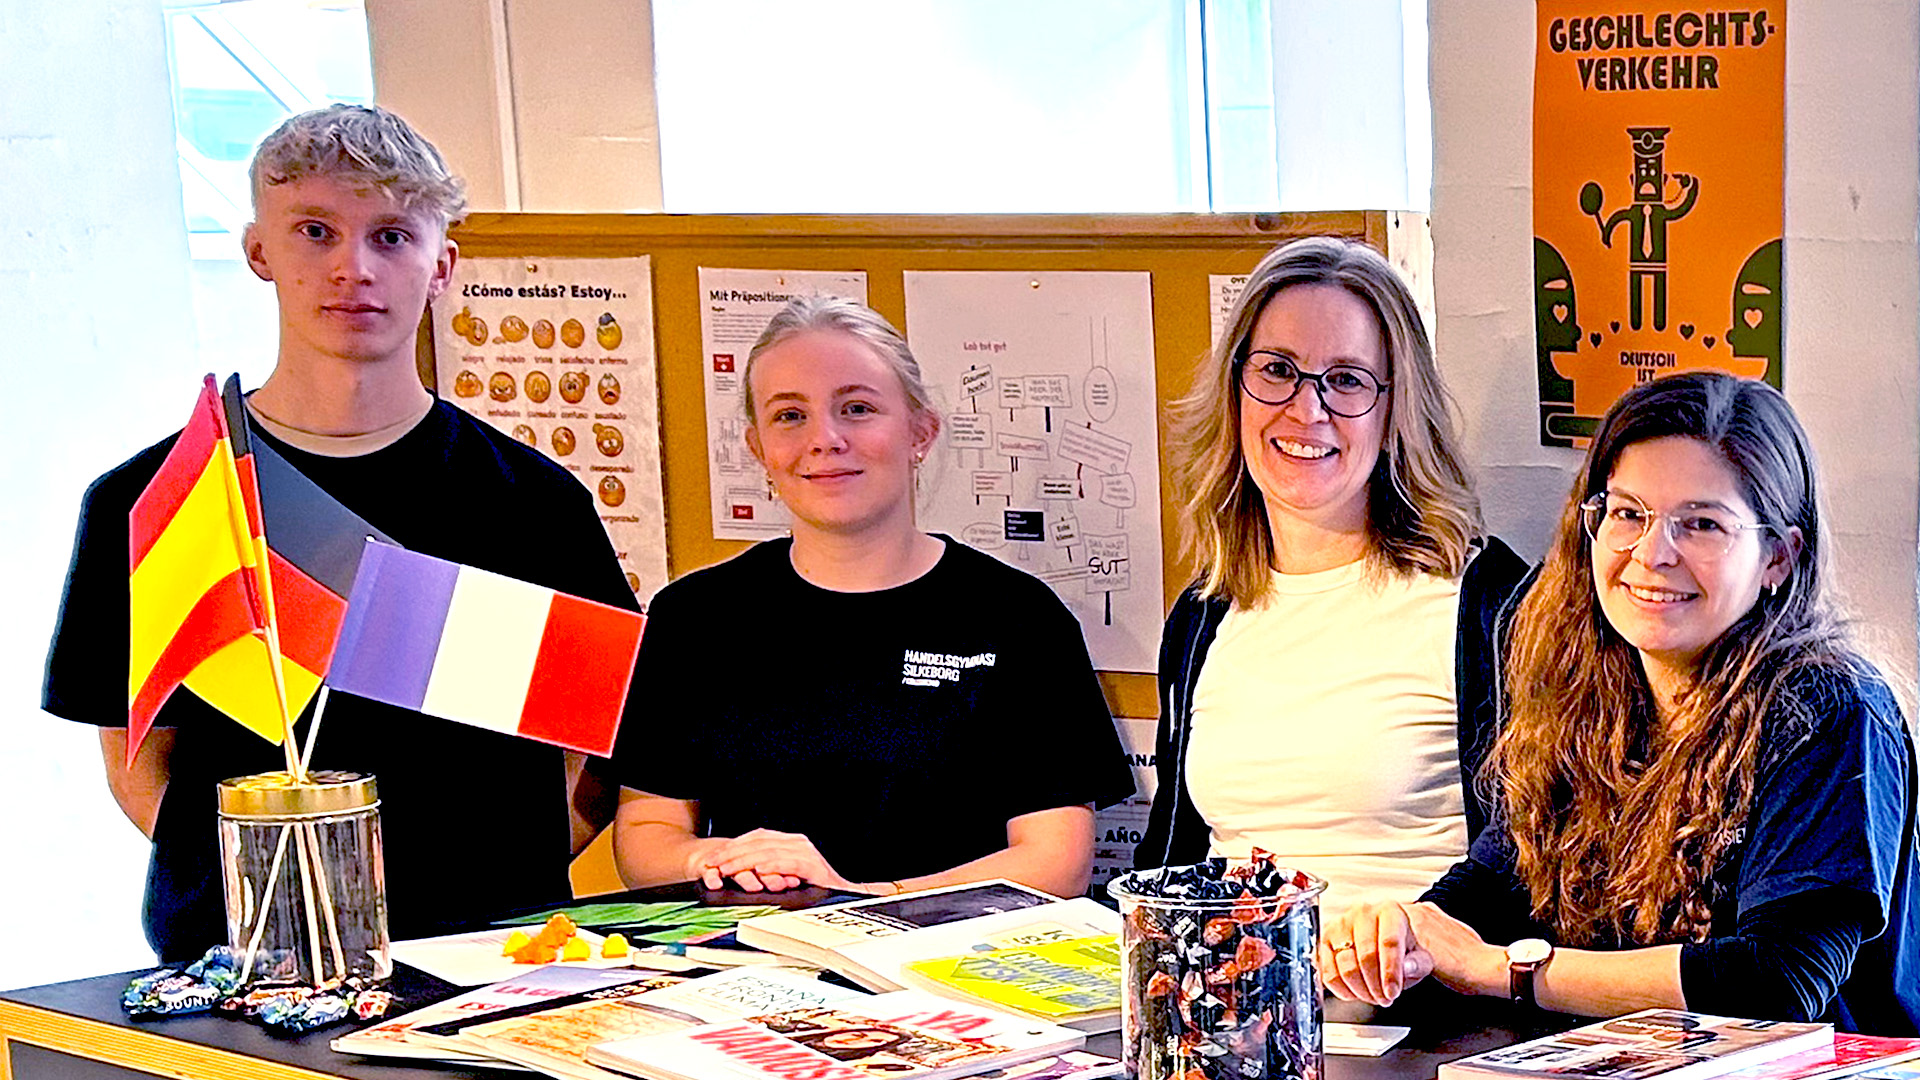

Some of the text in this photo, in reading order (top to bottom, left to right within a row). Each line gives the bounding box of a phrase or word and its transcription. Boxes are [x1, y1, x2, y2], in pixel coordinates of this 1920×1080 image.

[1549, 11, 1775, 53] GESCHLECHTS-
[1577, 55, 1720, 91] VERKEHR
[462, 283, 627, 301] ¿Cómo estás? Estoy...
[710, 290, 728, 301] Mit
[1620, 351, 1675, 368] DEUTSCH
[1637, 368, 1655, 382] IST
[902, 663, 961, 682] SILKEBORG
[1104, 826, 1143, 845] AÑO
[165, 992, 219, 1012] BOUNTY
